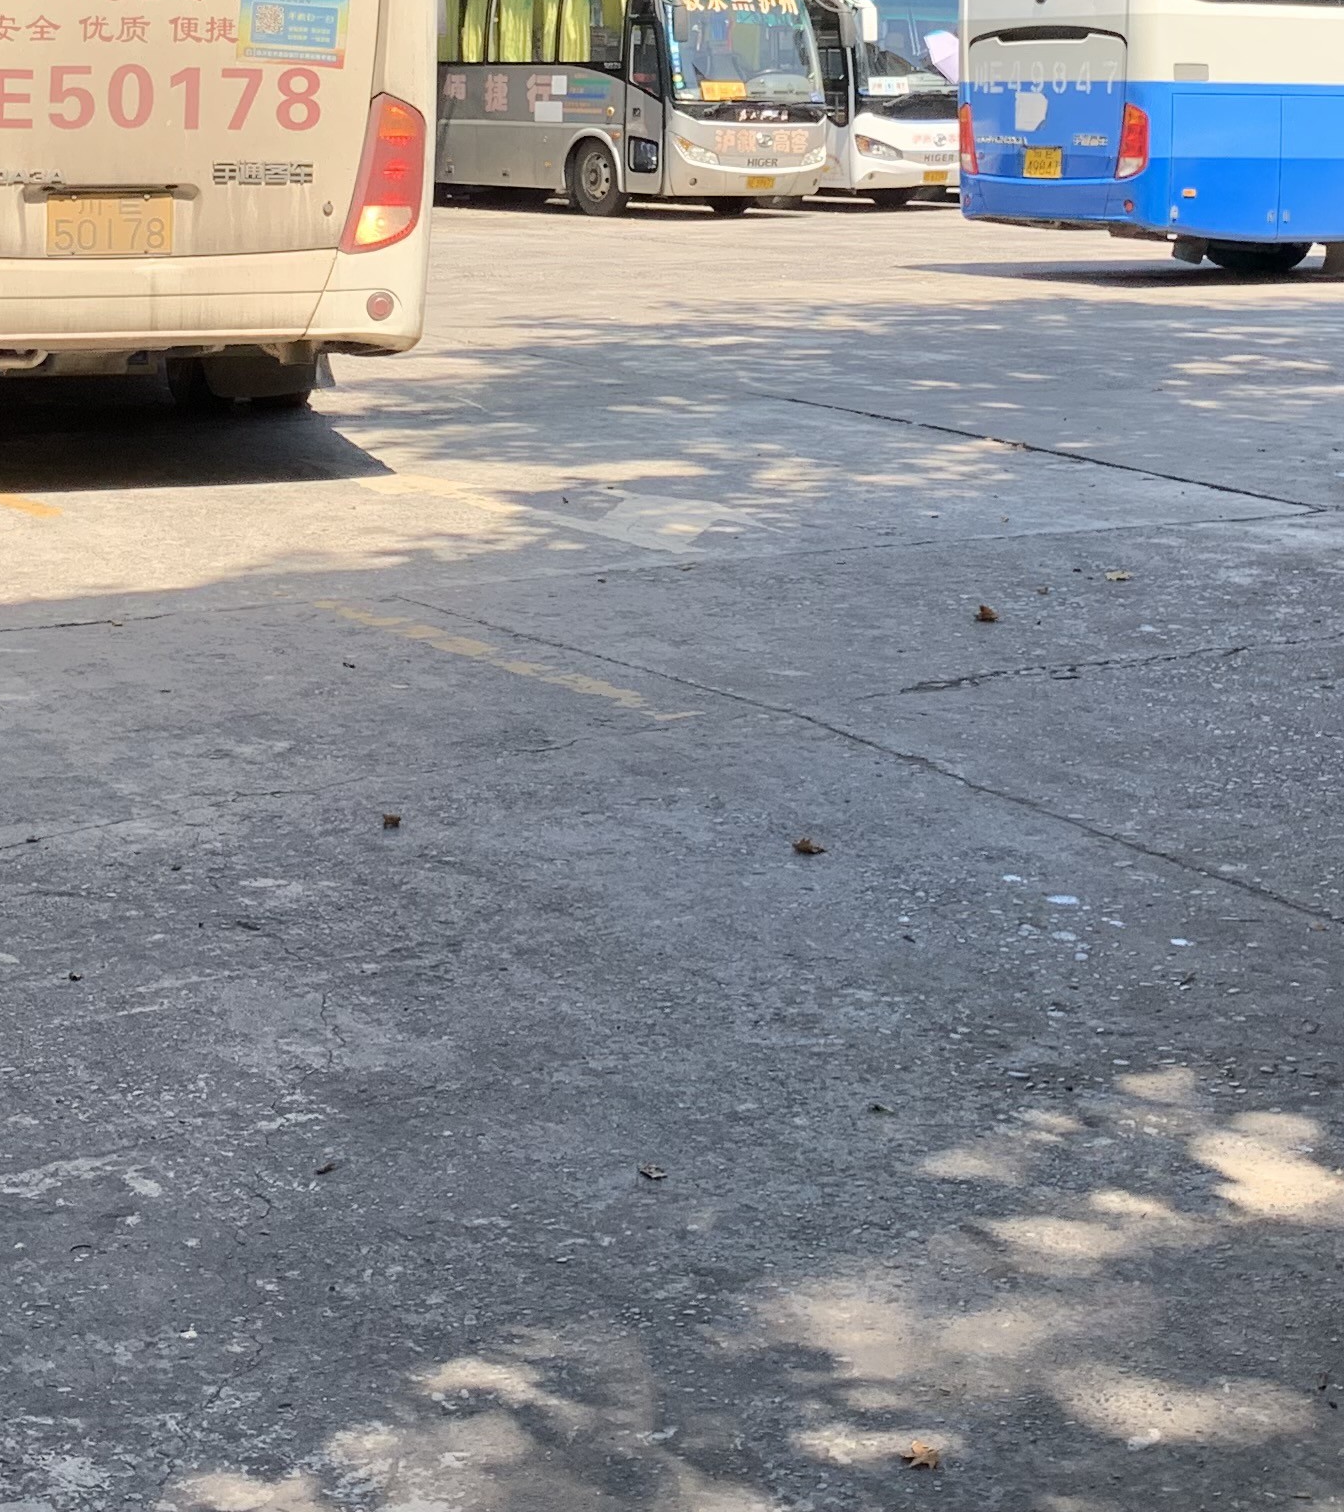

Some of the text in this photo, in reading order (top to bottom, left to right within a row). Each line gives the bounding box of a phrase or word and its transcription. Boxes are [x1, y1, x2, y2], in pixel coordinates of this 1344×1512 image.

[78, 15, 151, 44] 优质
[168, 15, 239, 44] 便捷
[747, 158, 778, 168] HIGER
[924, 154, 955, 163] HIGER
[212, 160, 314, 186] 宇通客车
[54, 217, 165, 251] 50178
